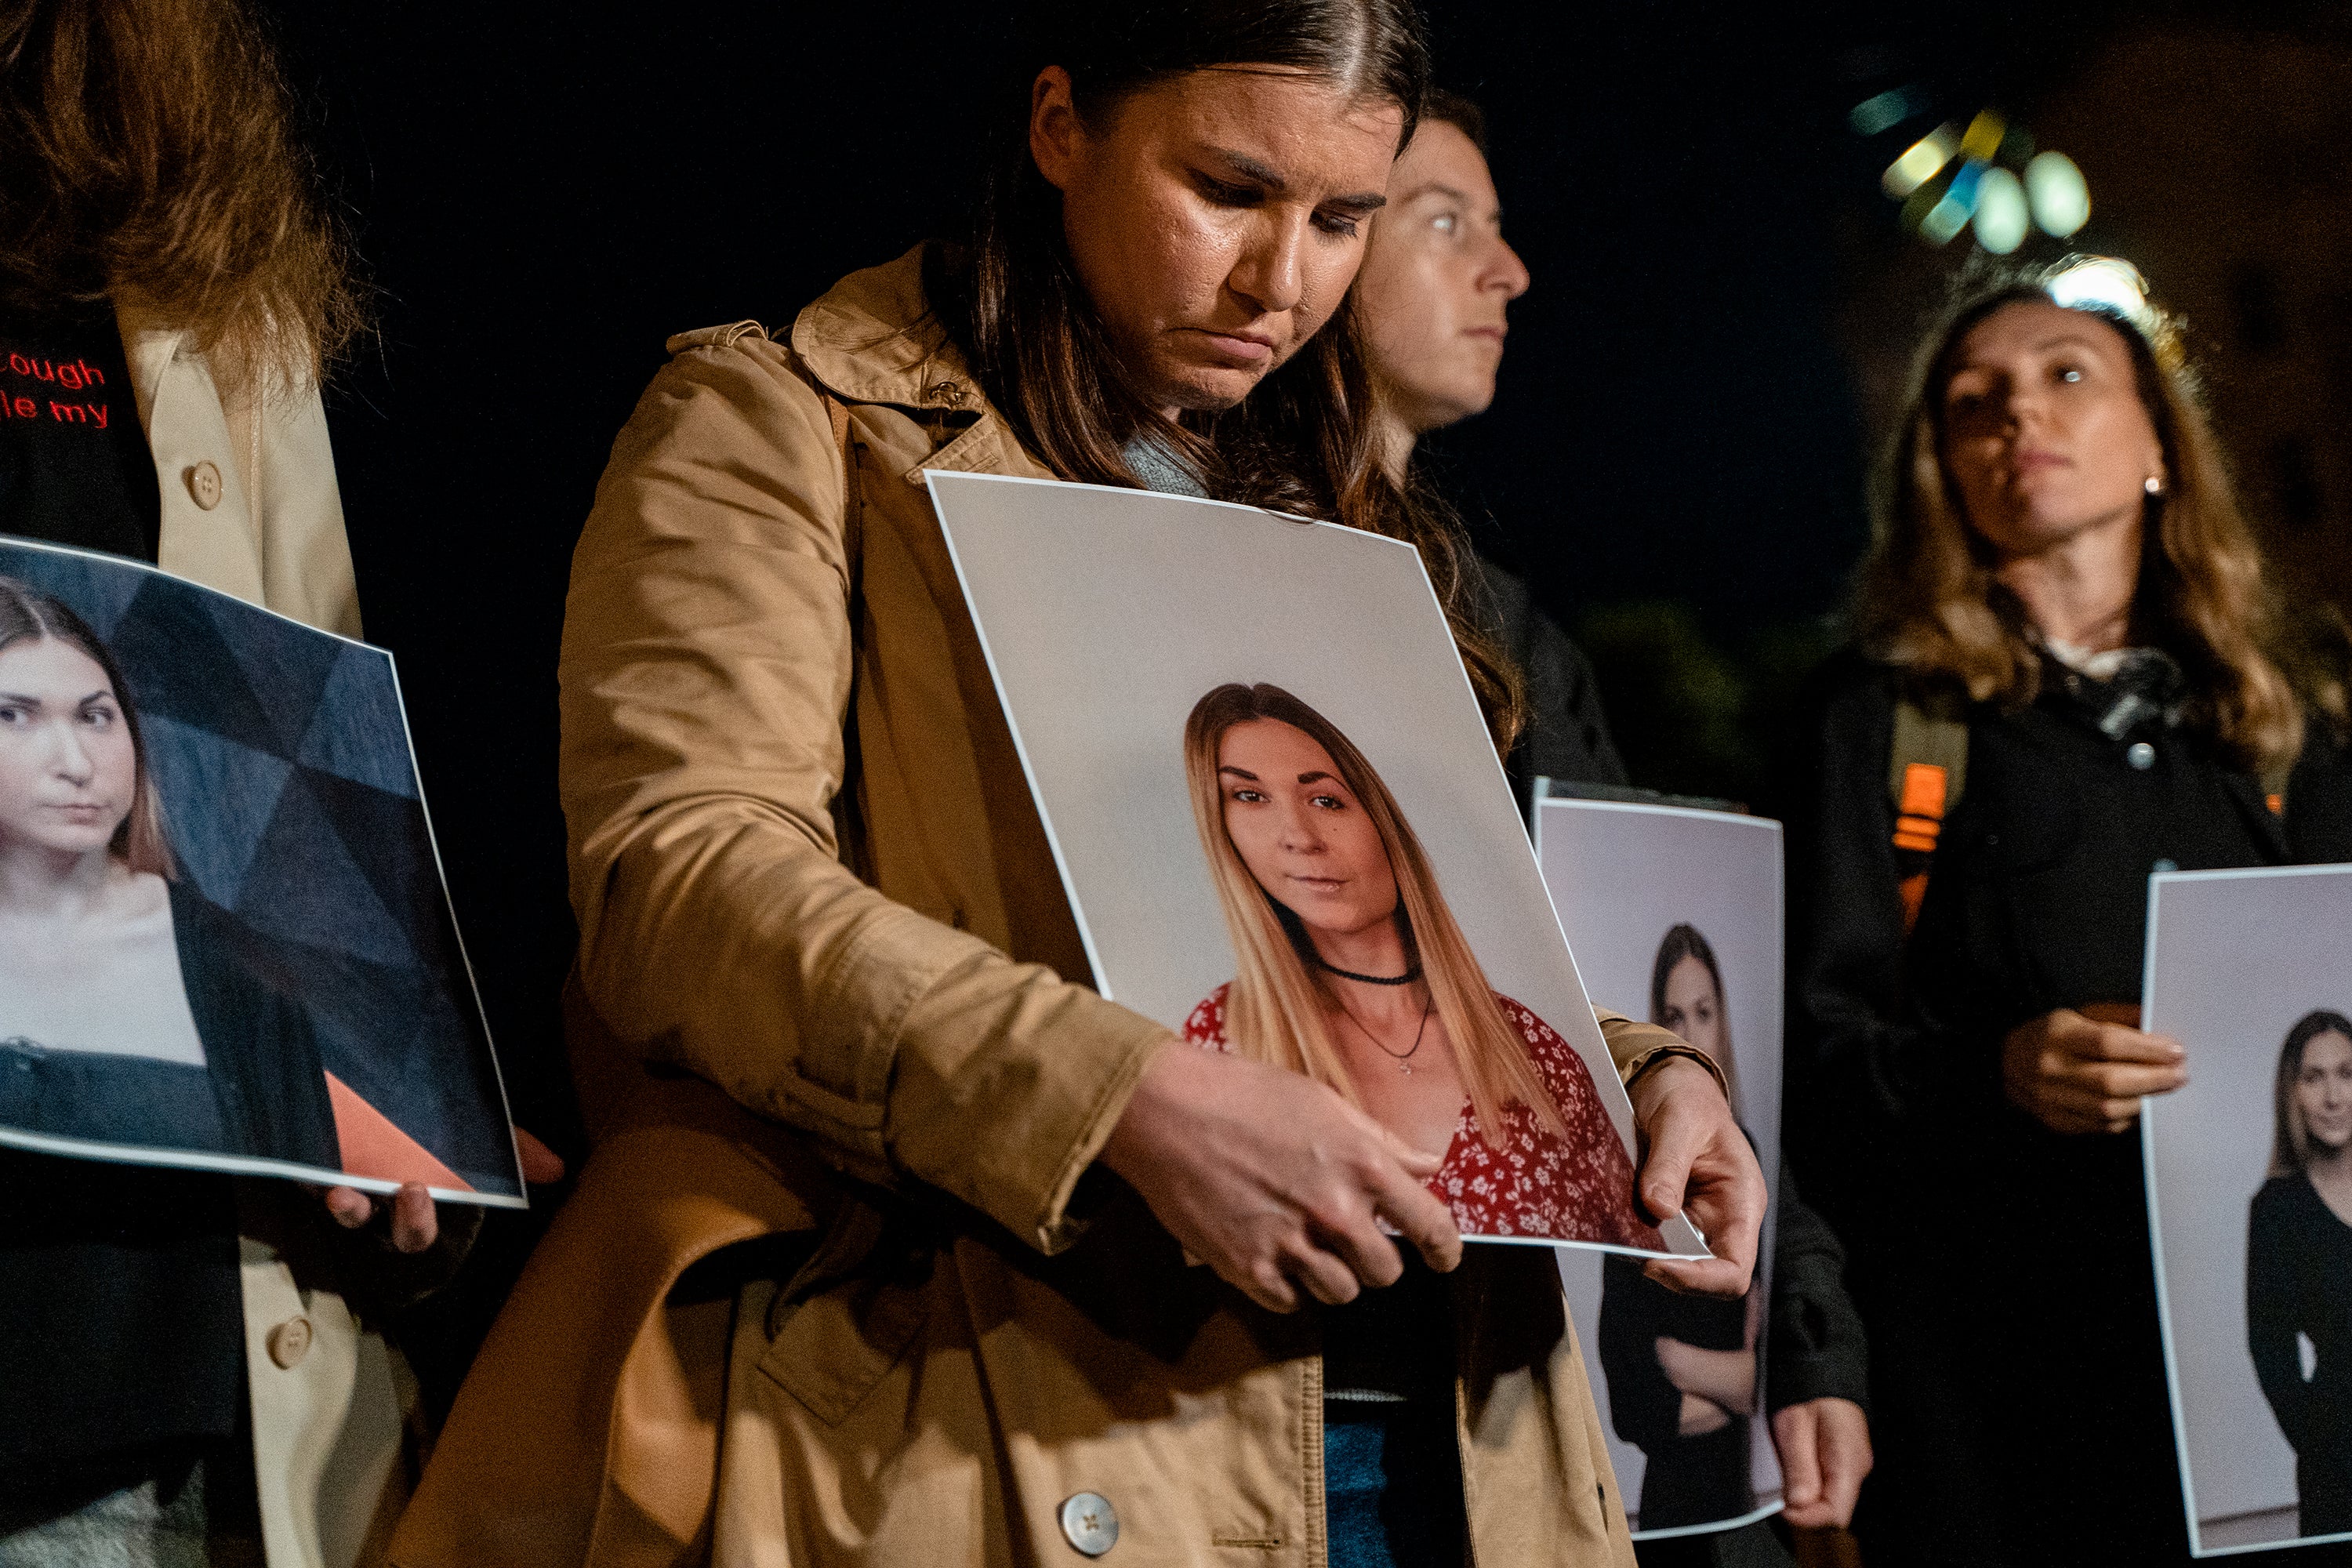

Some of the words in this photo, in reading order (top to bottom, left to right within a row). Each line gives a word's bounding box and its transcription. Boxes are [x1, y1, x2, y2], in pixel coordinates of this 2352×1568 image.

[0, 352, 105, 390] ough
[0, 390, 38, 418] le
[49, 401, 107, 429] my
